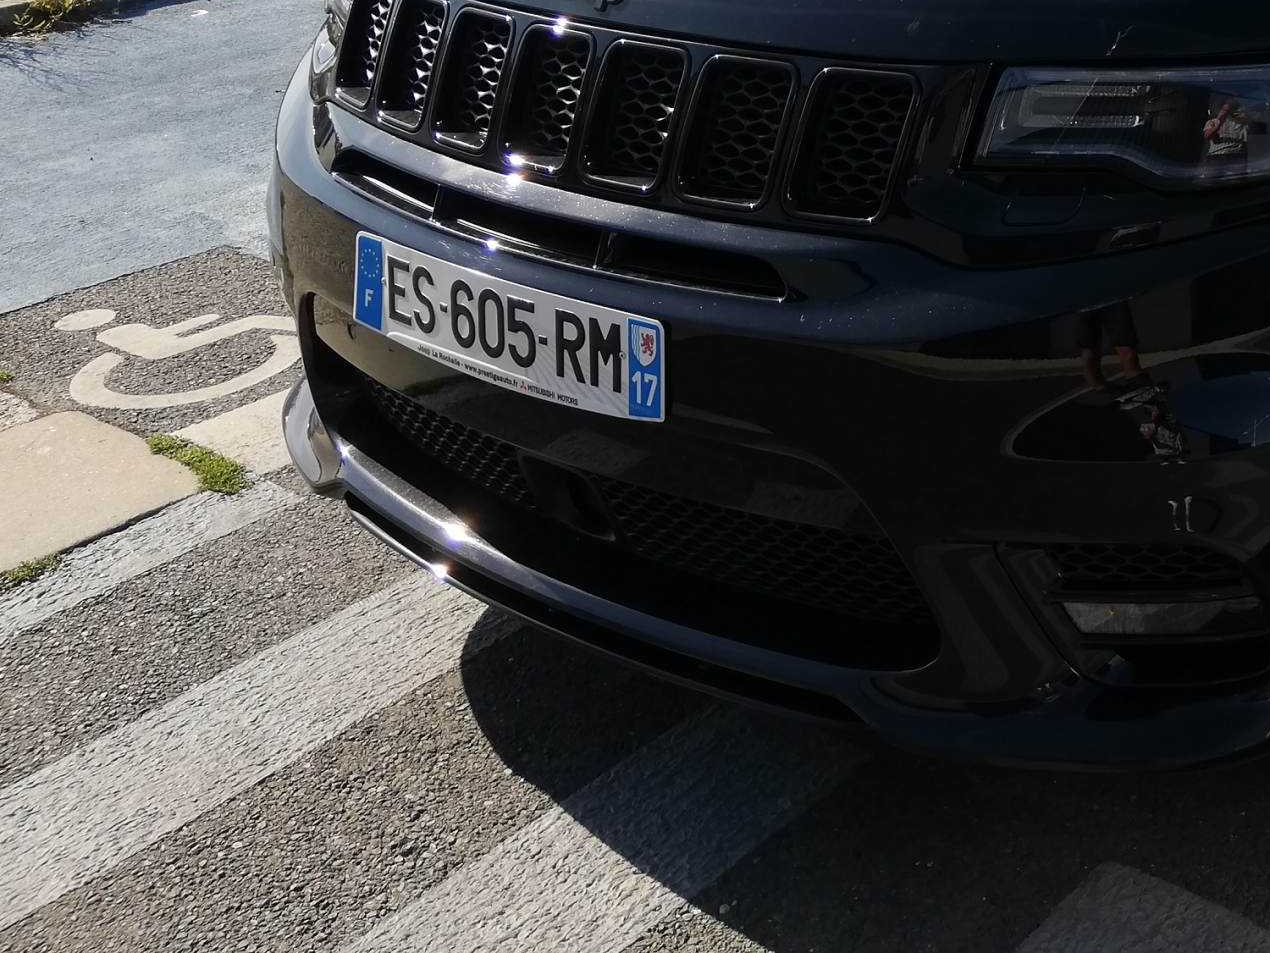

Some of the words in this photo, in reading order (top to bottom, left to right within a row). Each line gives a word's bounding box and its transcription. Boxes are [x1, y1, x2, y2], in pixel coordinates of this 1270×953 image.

[363, 288, 374, 308] F
[386, 255, 622, 394] ES-605-RM
[439, 352, 460, 367] Rochelle
[464, 363, 518, 387] www.prestigeauto.fr
[527, 384, 556, 400] MITSUBISHI
[557, 393, 579, 406] MOTORS
[631, 370, 658, 407] 17
